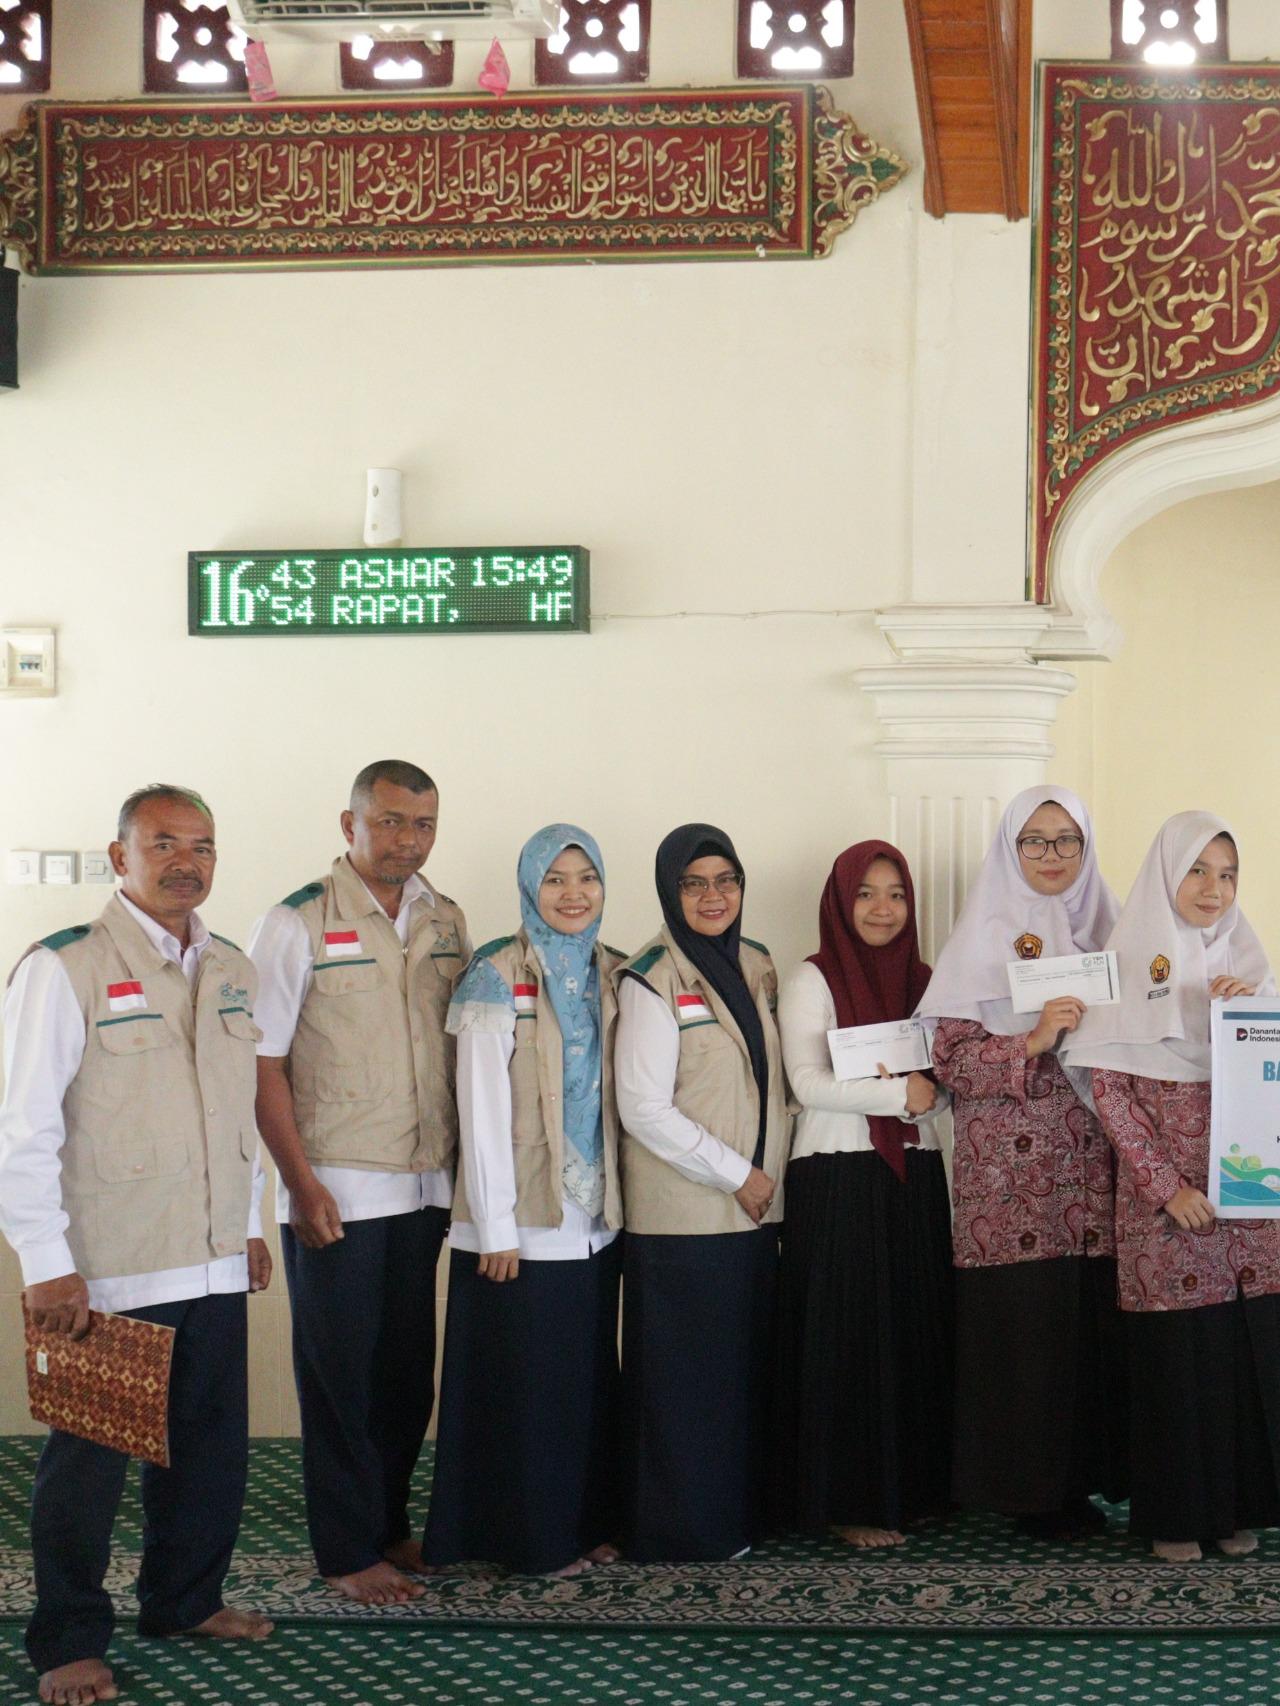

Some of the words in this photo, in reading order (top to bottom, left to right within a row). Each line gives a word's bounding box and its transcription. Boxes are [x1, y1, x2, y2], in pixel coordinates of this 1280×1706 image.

[271, 559, 316, 589] 43
[340, 558, 455, 588] ASHAR
[472, 555, 572, 585] 15:49
[271, 596, 316, 624] 54
[332, 593, 459, 624] RAPAT,
